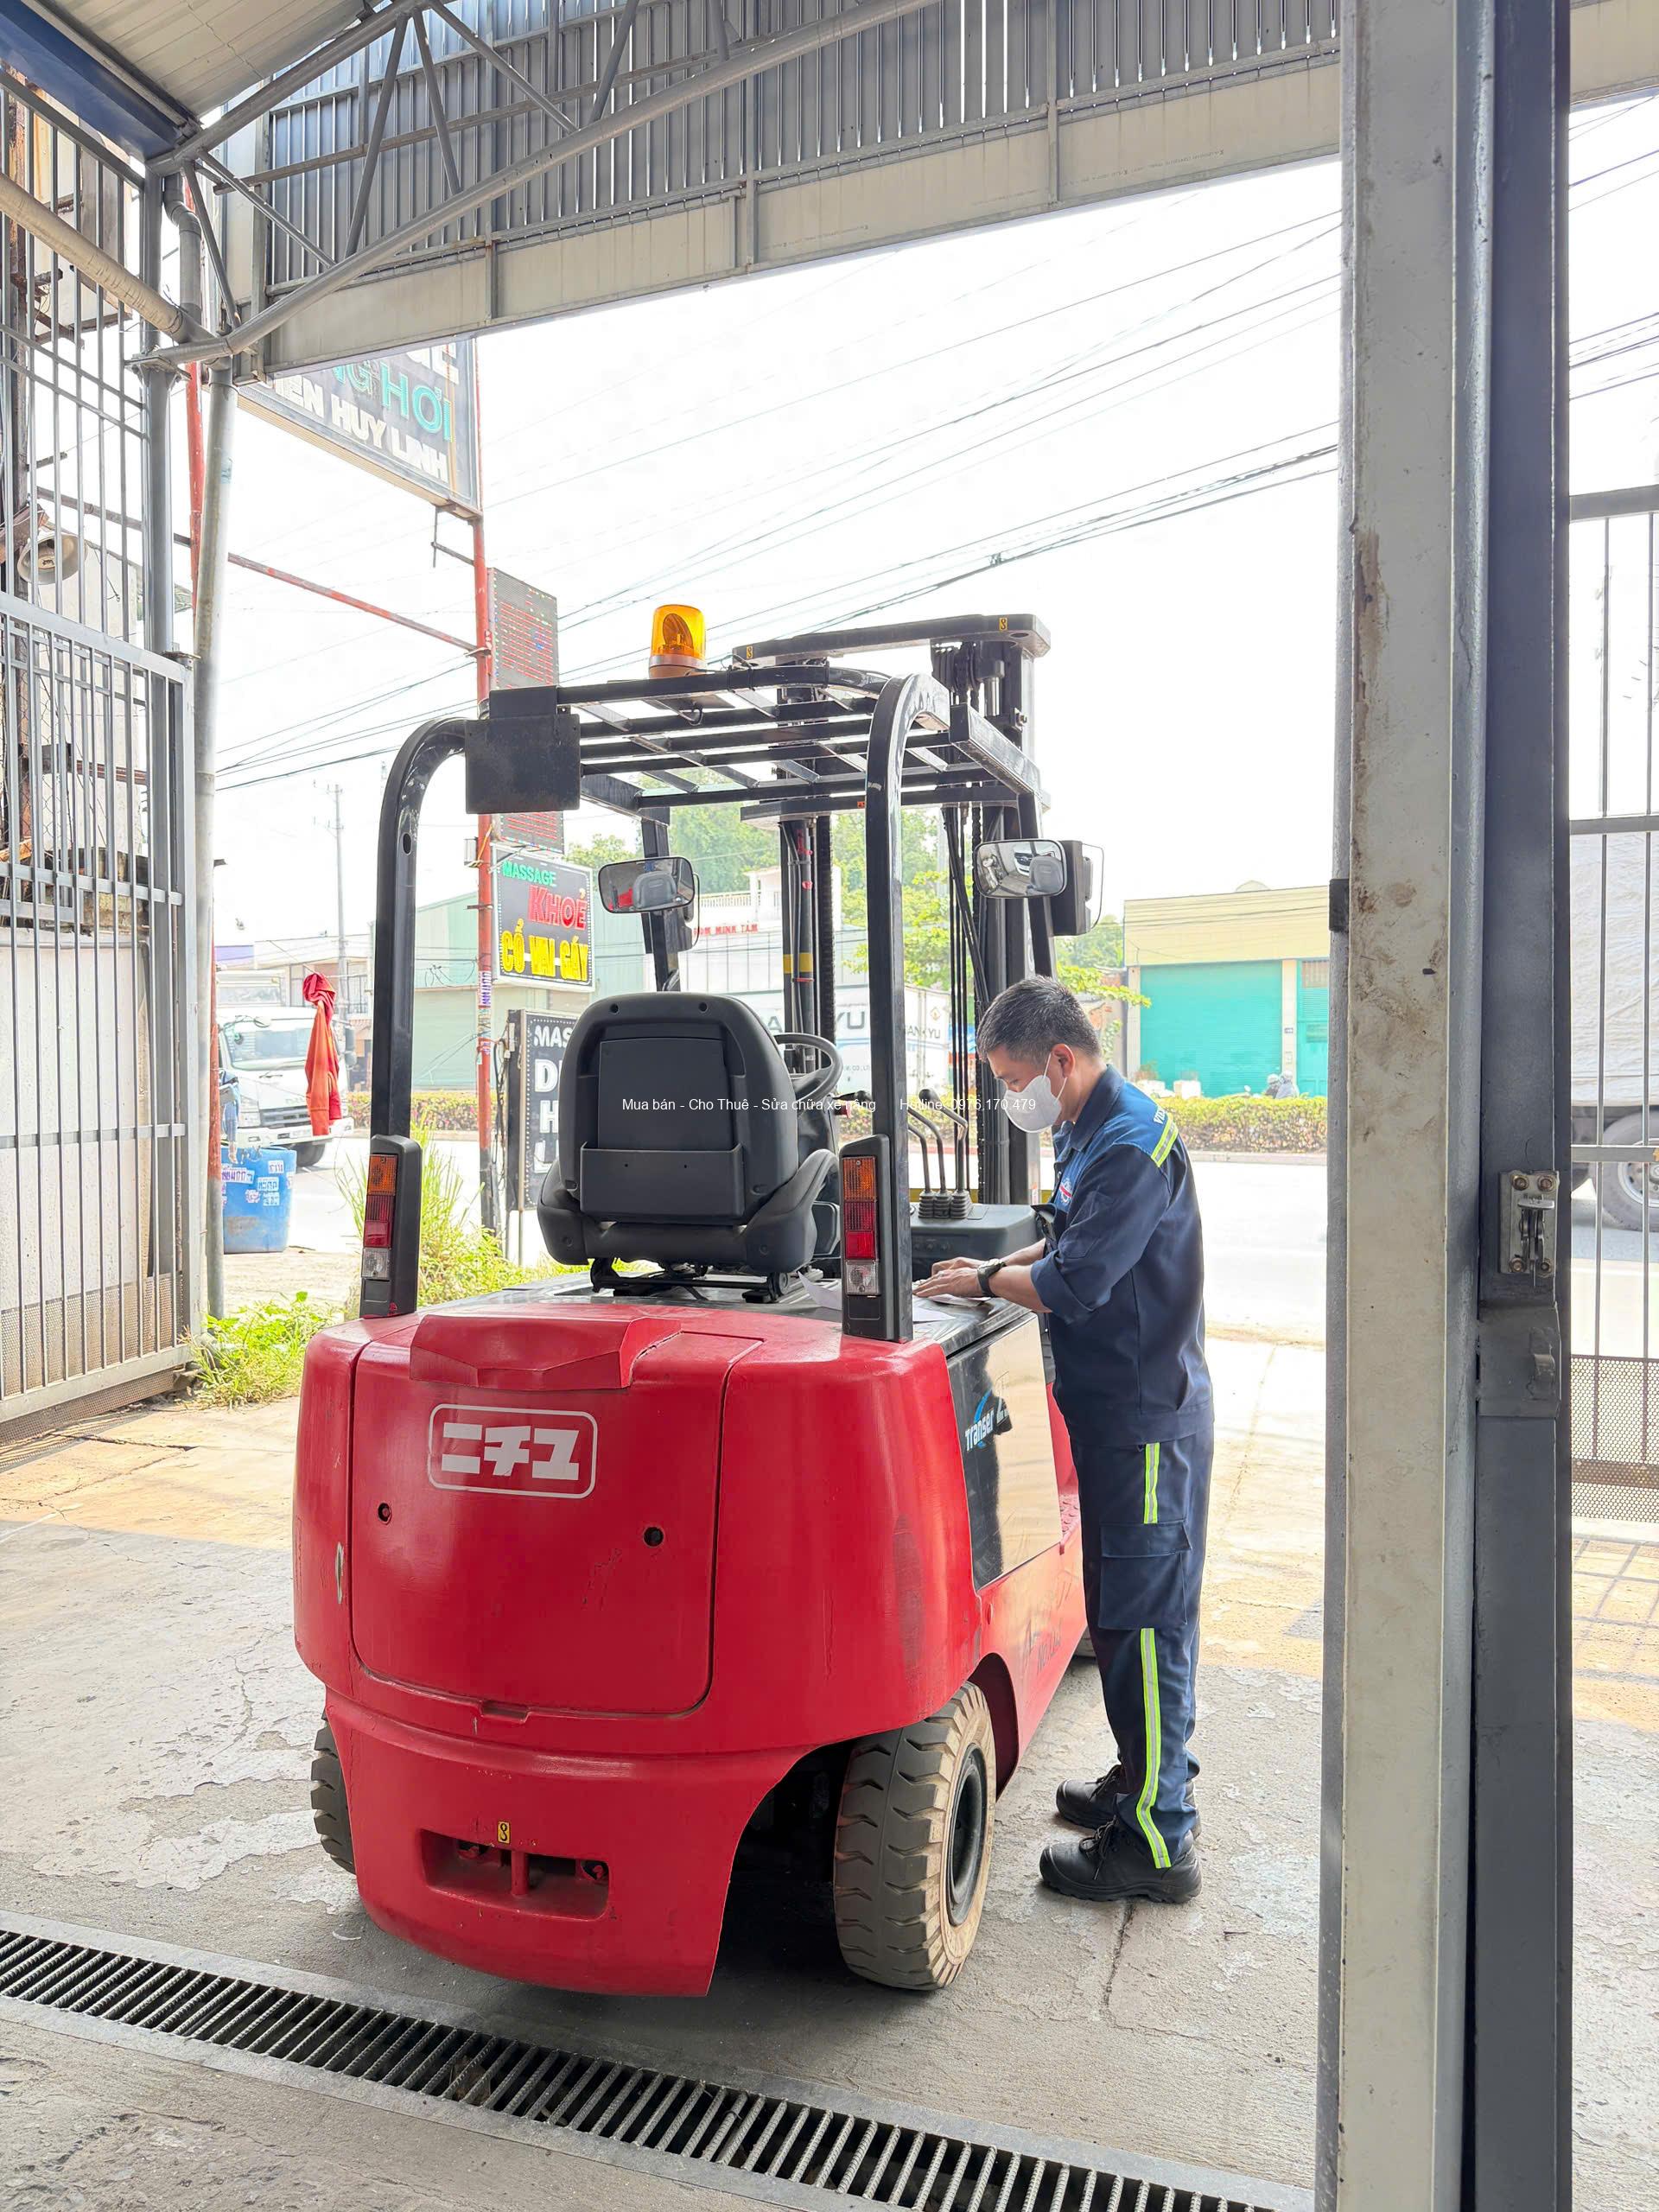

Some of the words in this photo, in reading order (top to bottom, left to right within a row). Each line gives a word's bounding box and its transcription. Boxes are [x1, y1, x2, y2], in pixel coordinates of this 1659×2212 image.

[331, 393, 386, 448] HUY
[391, 426, 448, 483] LINH
[502, 860, 557, 887] MASSAGE
[528, 887, 588, 931] KHOẺ
